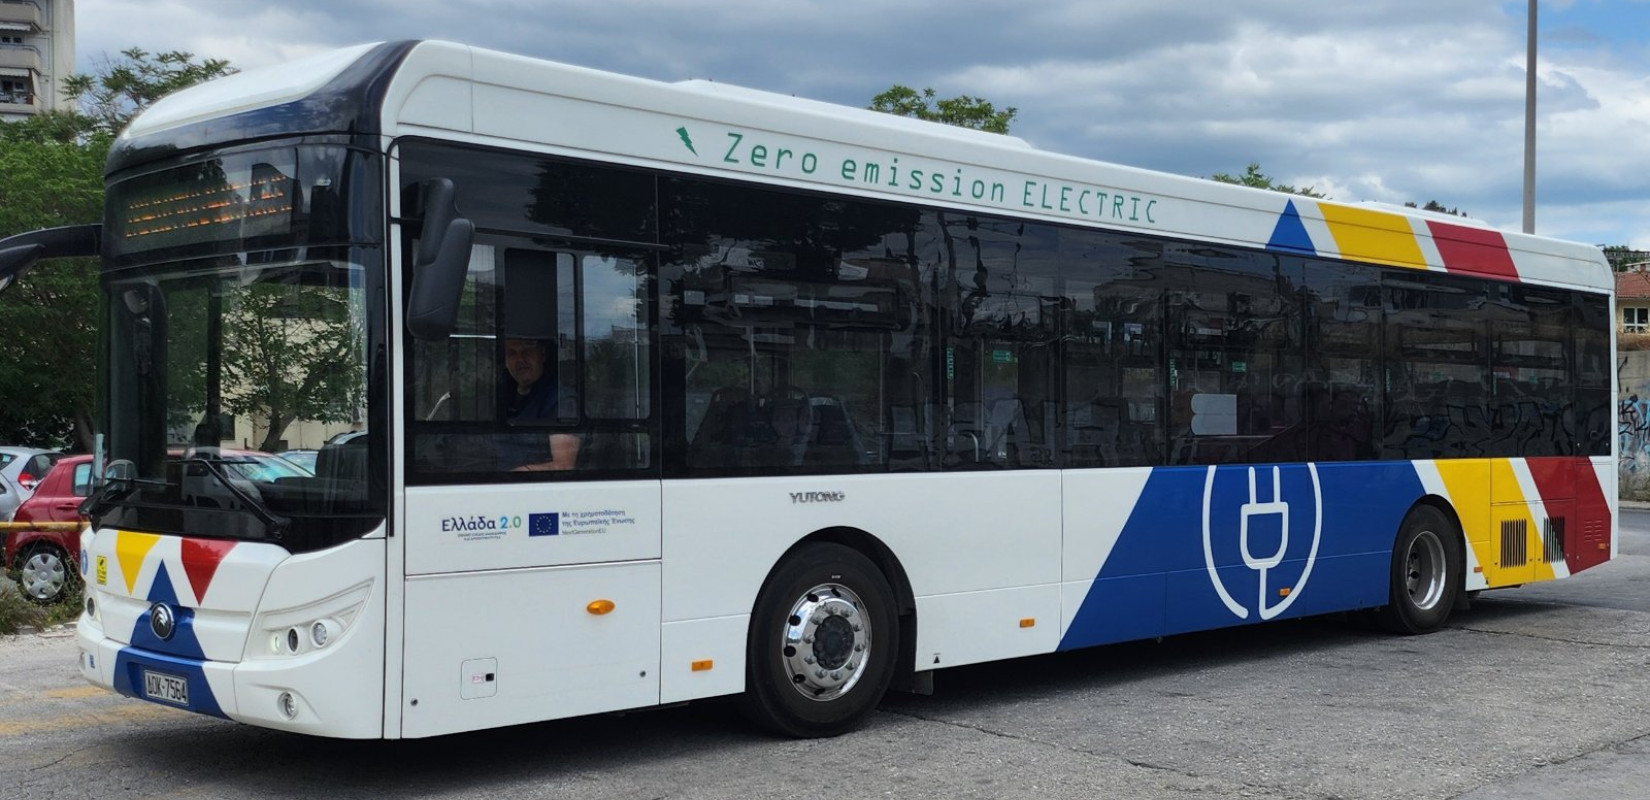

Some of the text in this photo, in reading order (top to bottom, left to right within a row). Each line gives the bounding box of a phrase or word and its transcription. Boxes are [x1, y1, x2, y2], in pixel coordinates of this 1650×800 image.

[724, 132, 1157, 224] Zero emission ELECTRIC
[789, 491, 845, 504] YUTONG
[442, 515, 522, 532] Ελλάδα 2.0
